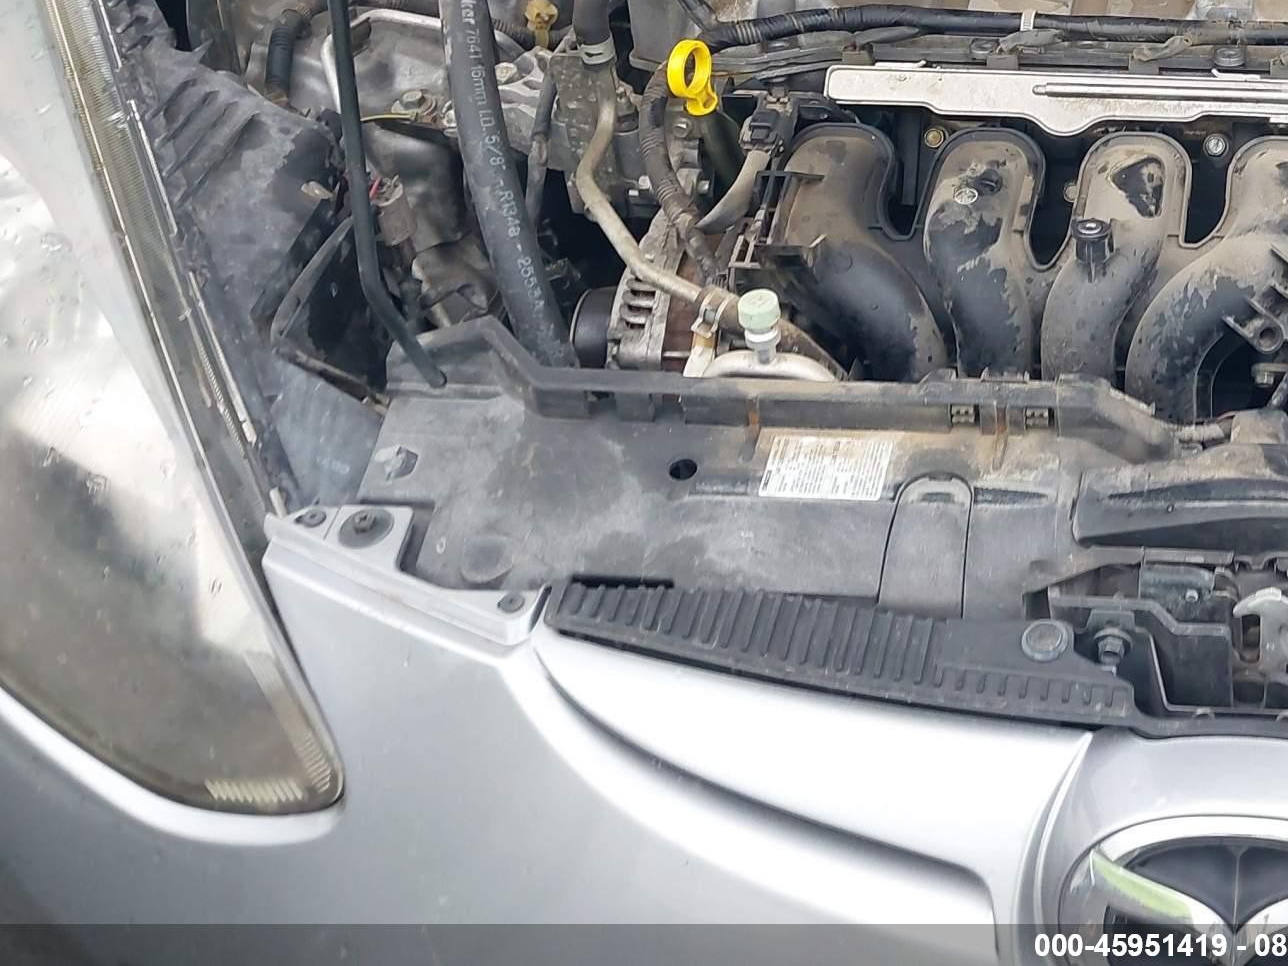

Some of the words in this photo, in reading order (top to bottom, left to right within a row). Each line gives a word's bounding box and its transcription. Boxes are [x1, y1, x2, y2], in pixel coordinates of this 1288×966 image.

[465, 28, 483, 59] 7641
[471, 63, 488, 106] 16mm
[499, 190, 521, 238] R134a
